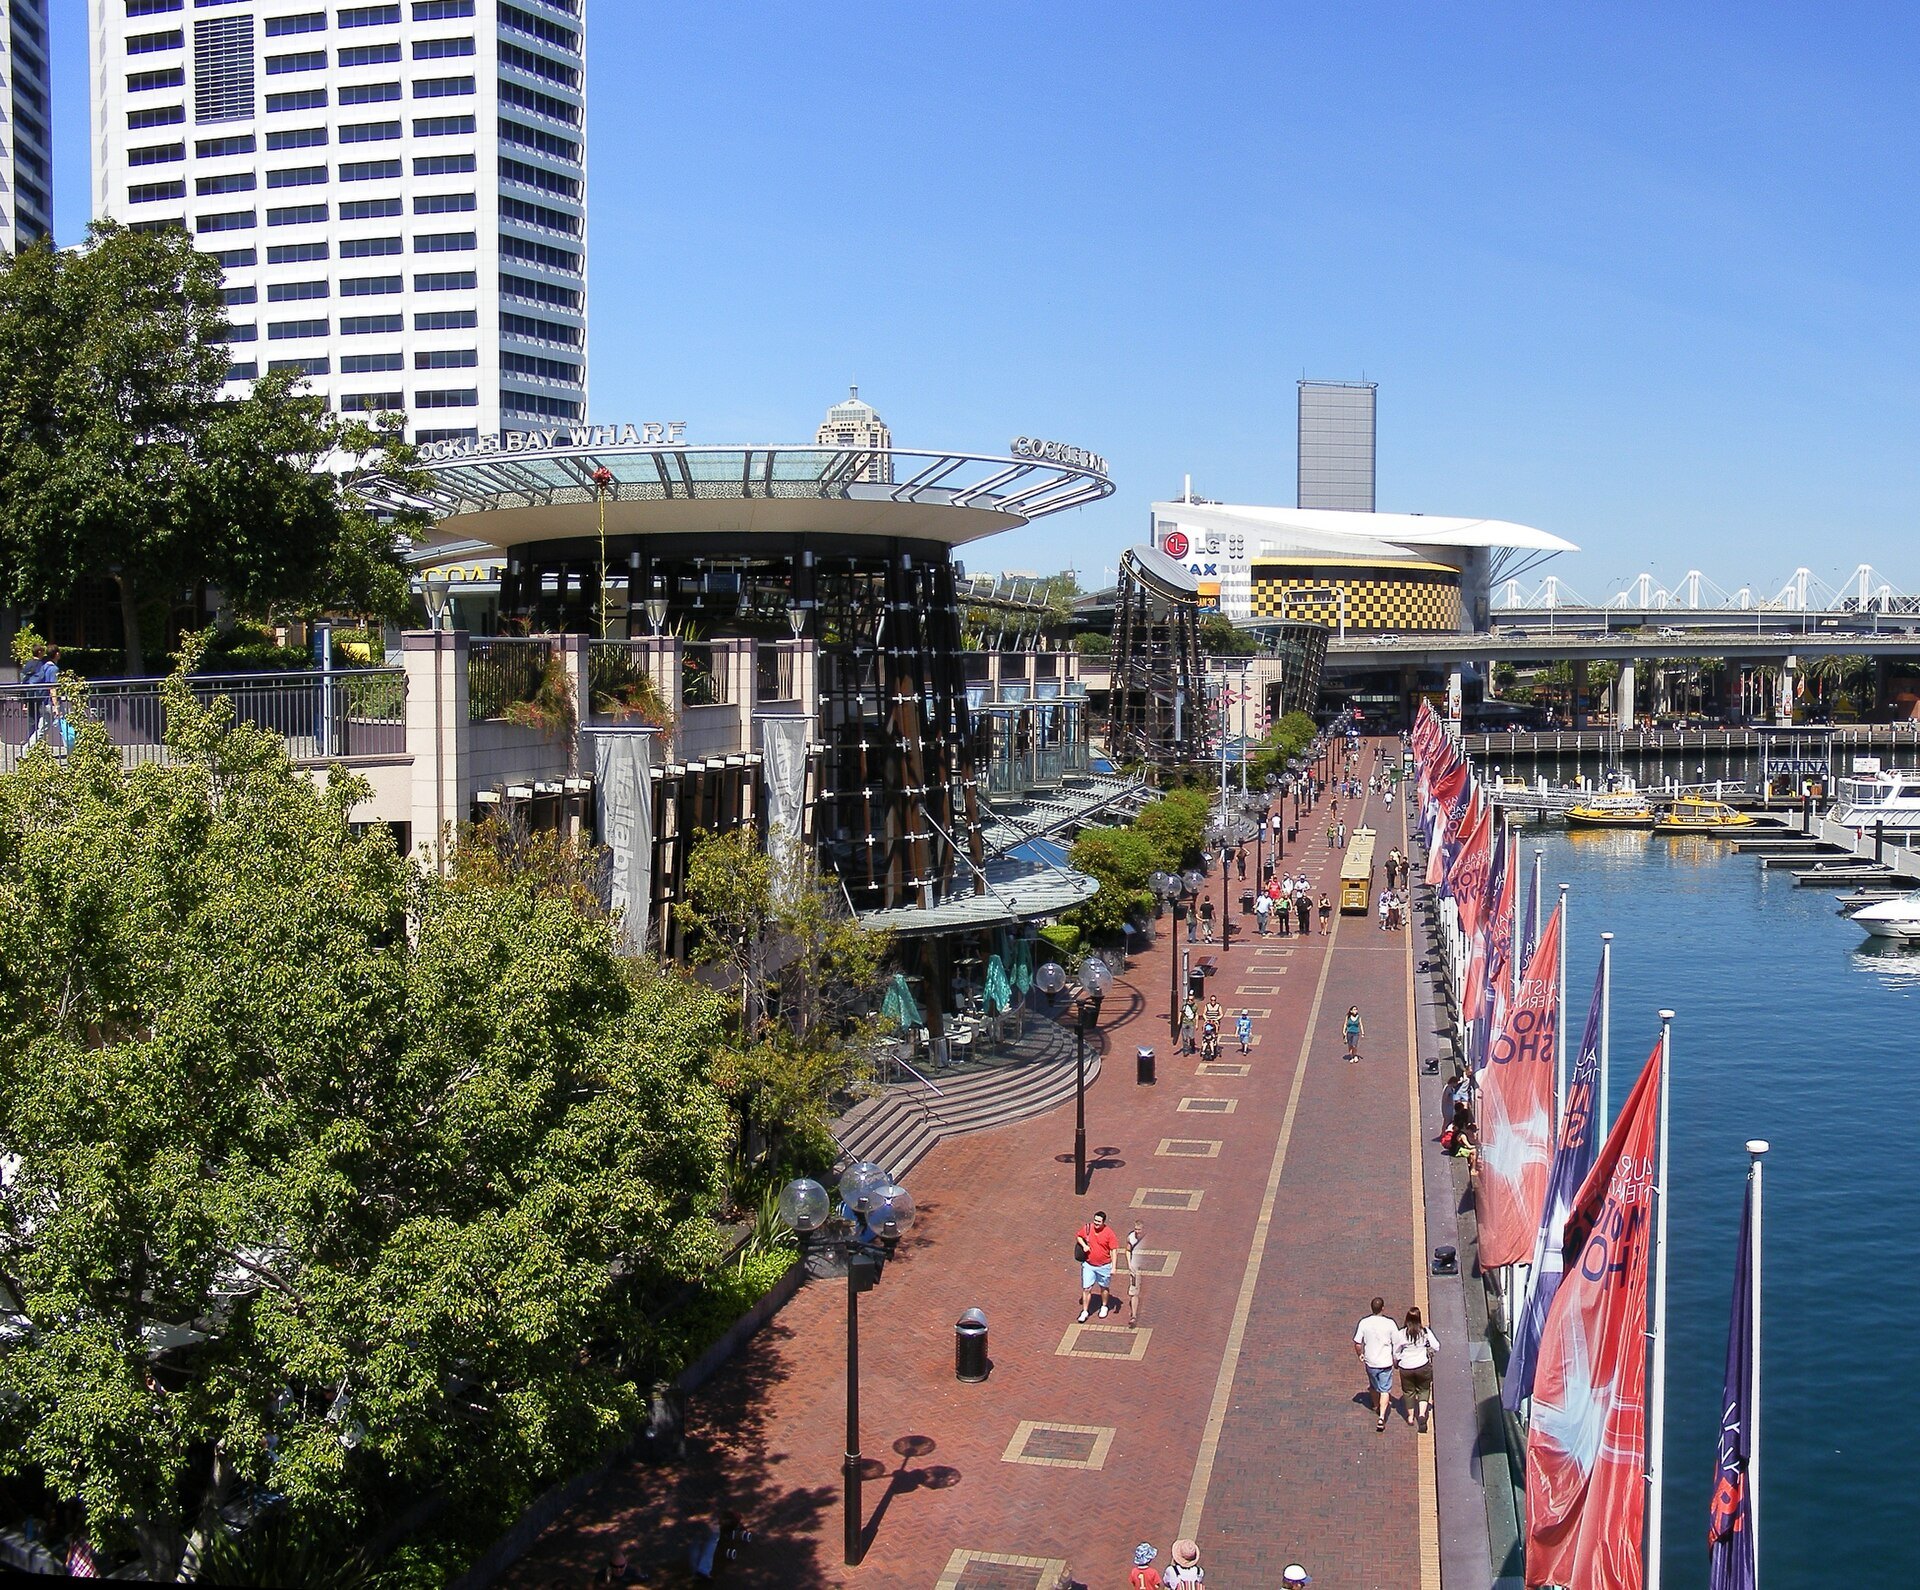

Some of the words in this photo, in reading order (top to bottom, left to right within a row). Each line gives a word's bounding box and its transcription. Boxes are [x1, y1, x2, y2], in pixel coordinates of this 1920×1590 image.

[418, 434, 498, 462] OCKLE
[505, 426, 560, 453] BAY
[567, 420, 687, 448] WHARF
[1769, 760, 1829, 775] MARINA
